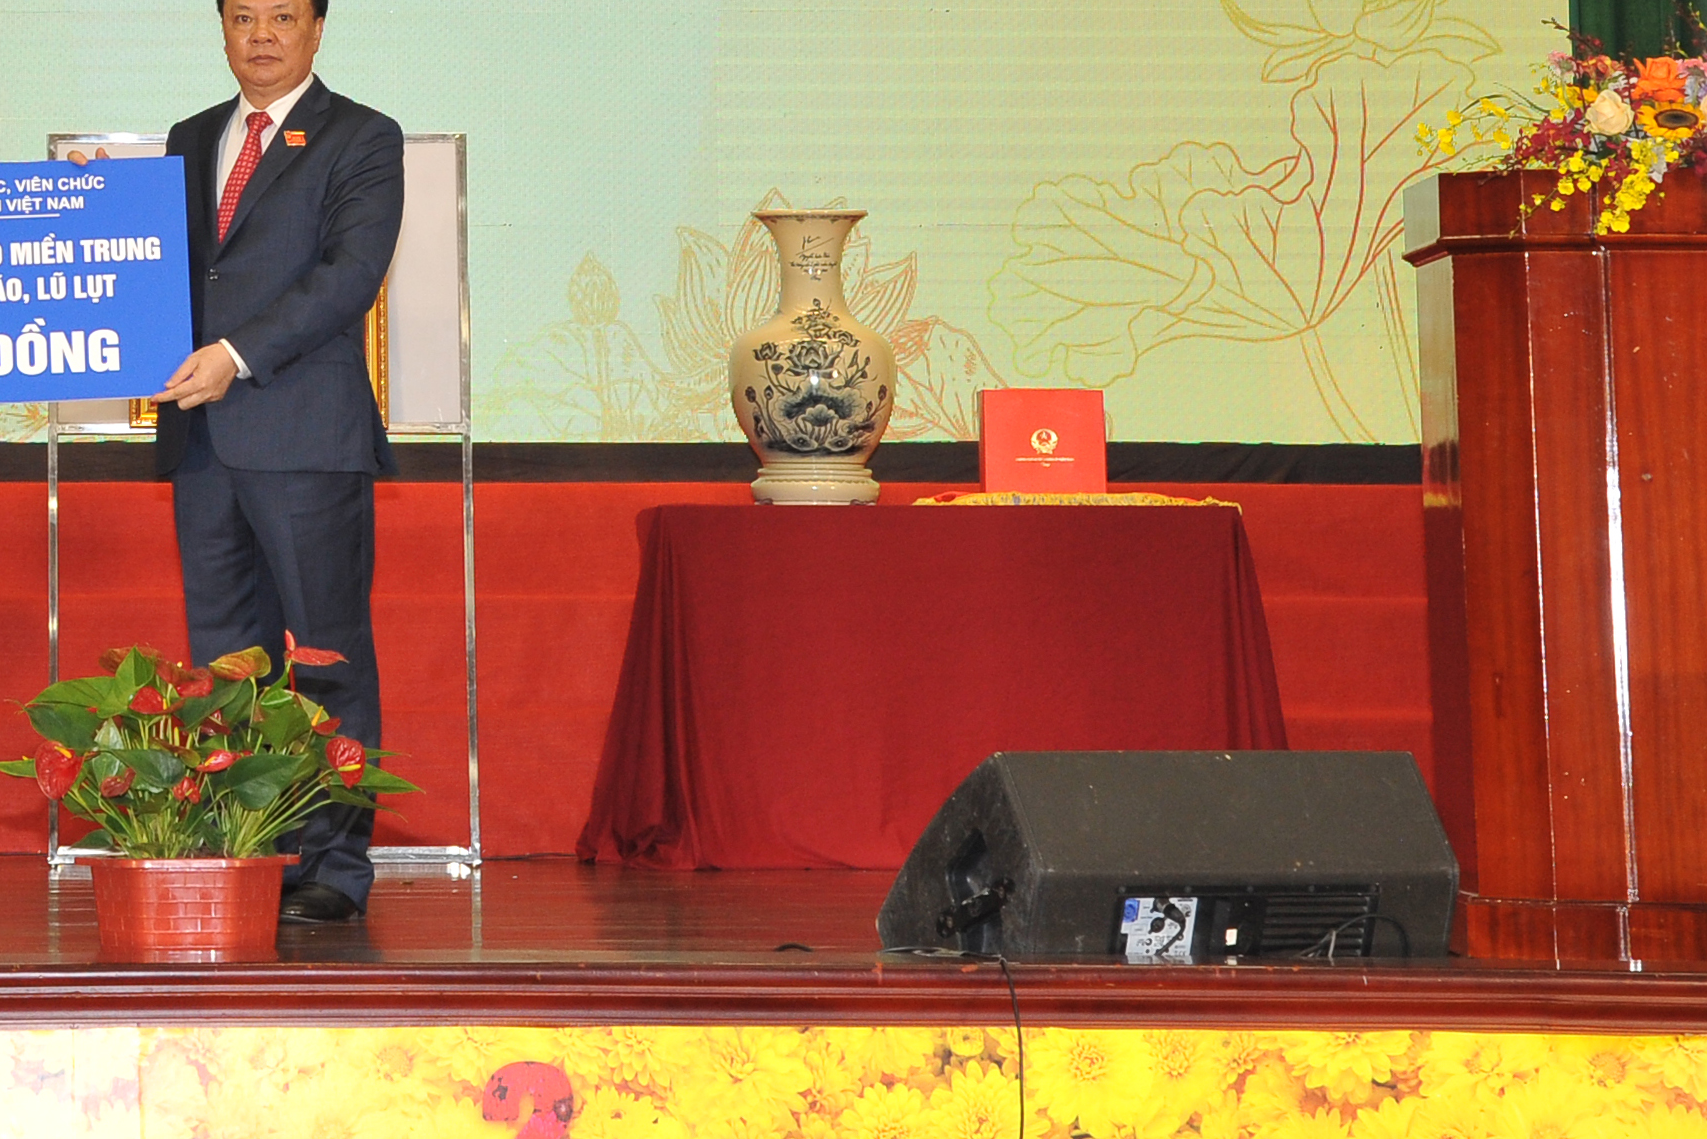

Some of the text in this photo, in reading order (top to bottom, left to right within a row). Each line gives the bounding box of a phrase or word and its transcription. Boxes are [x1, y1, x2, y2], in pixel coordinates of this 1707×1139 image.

[14, 175, 54, 193] VIÊN
[58, 173, 105, 192] CHỨC
[5, 193, 44, 214] VIỆT
[46, 195, 85, 211] NAM
[9, 232, 74, 266] MIỀN
[79, 236, 162, 264] TRUNG
[36, 271, 67, 301] LŨ
[73, 273, 117, 304] LỤT
